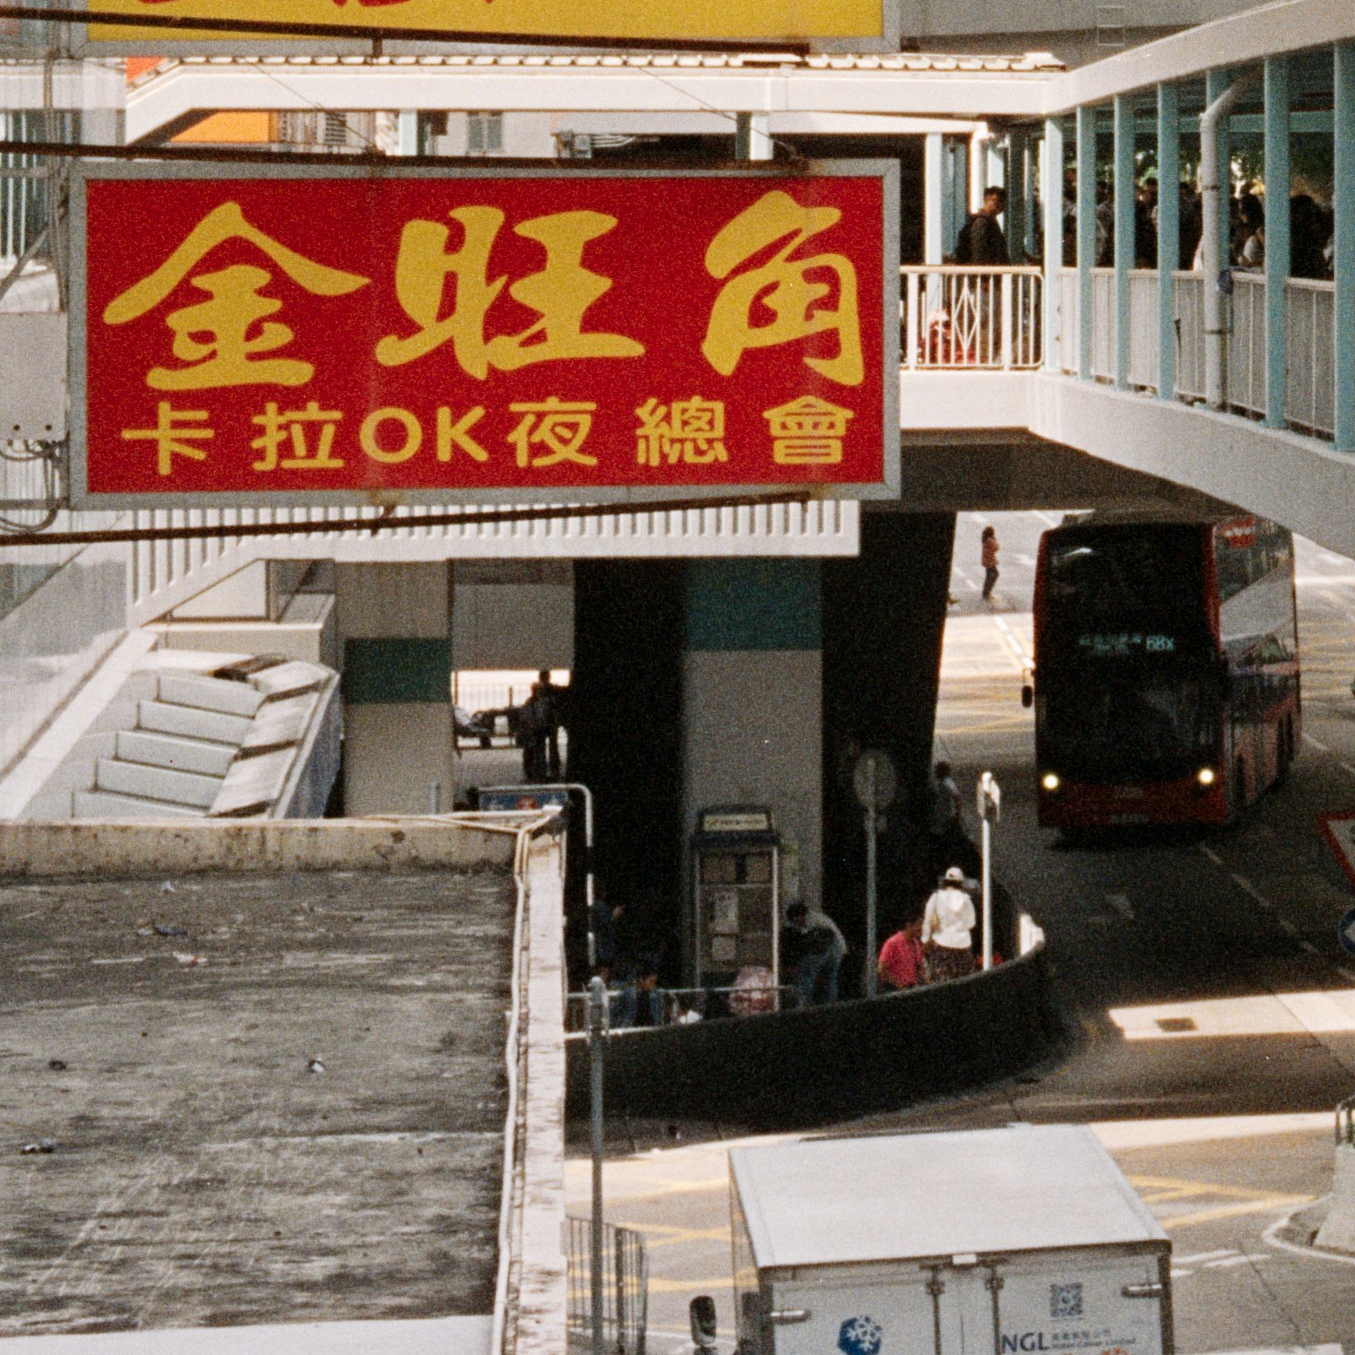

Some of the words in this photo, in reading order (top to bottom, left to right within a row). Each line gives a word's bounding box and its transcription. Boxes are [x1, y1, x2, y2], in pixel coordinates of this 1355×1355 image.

[102, 189, 867, 392] 金旺角
[1002, 1332, 1049, 1354] NGL
